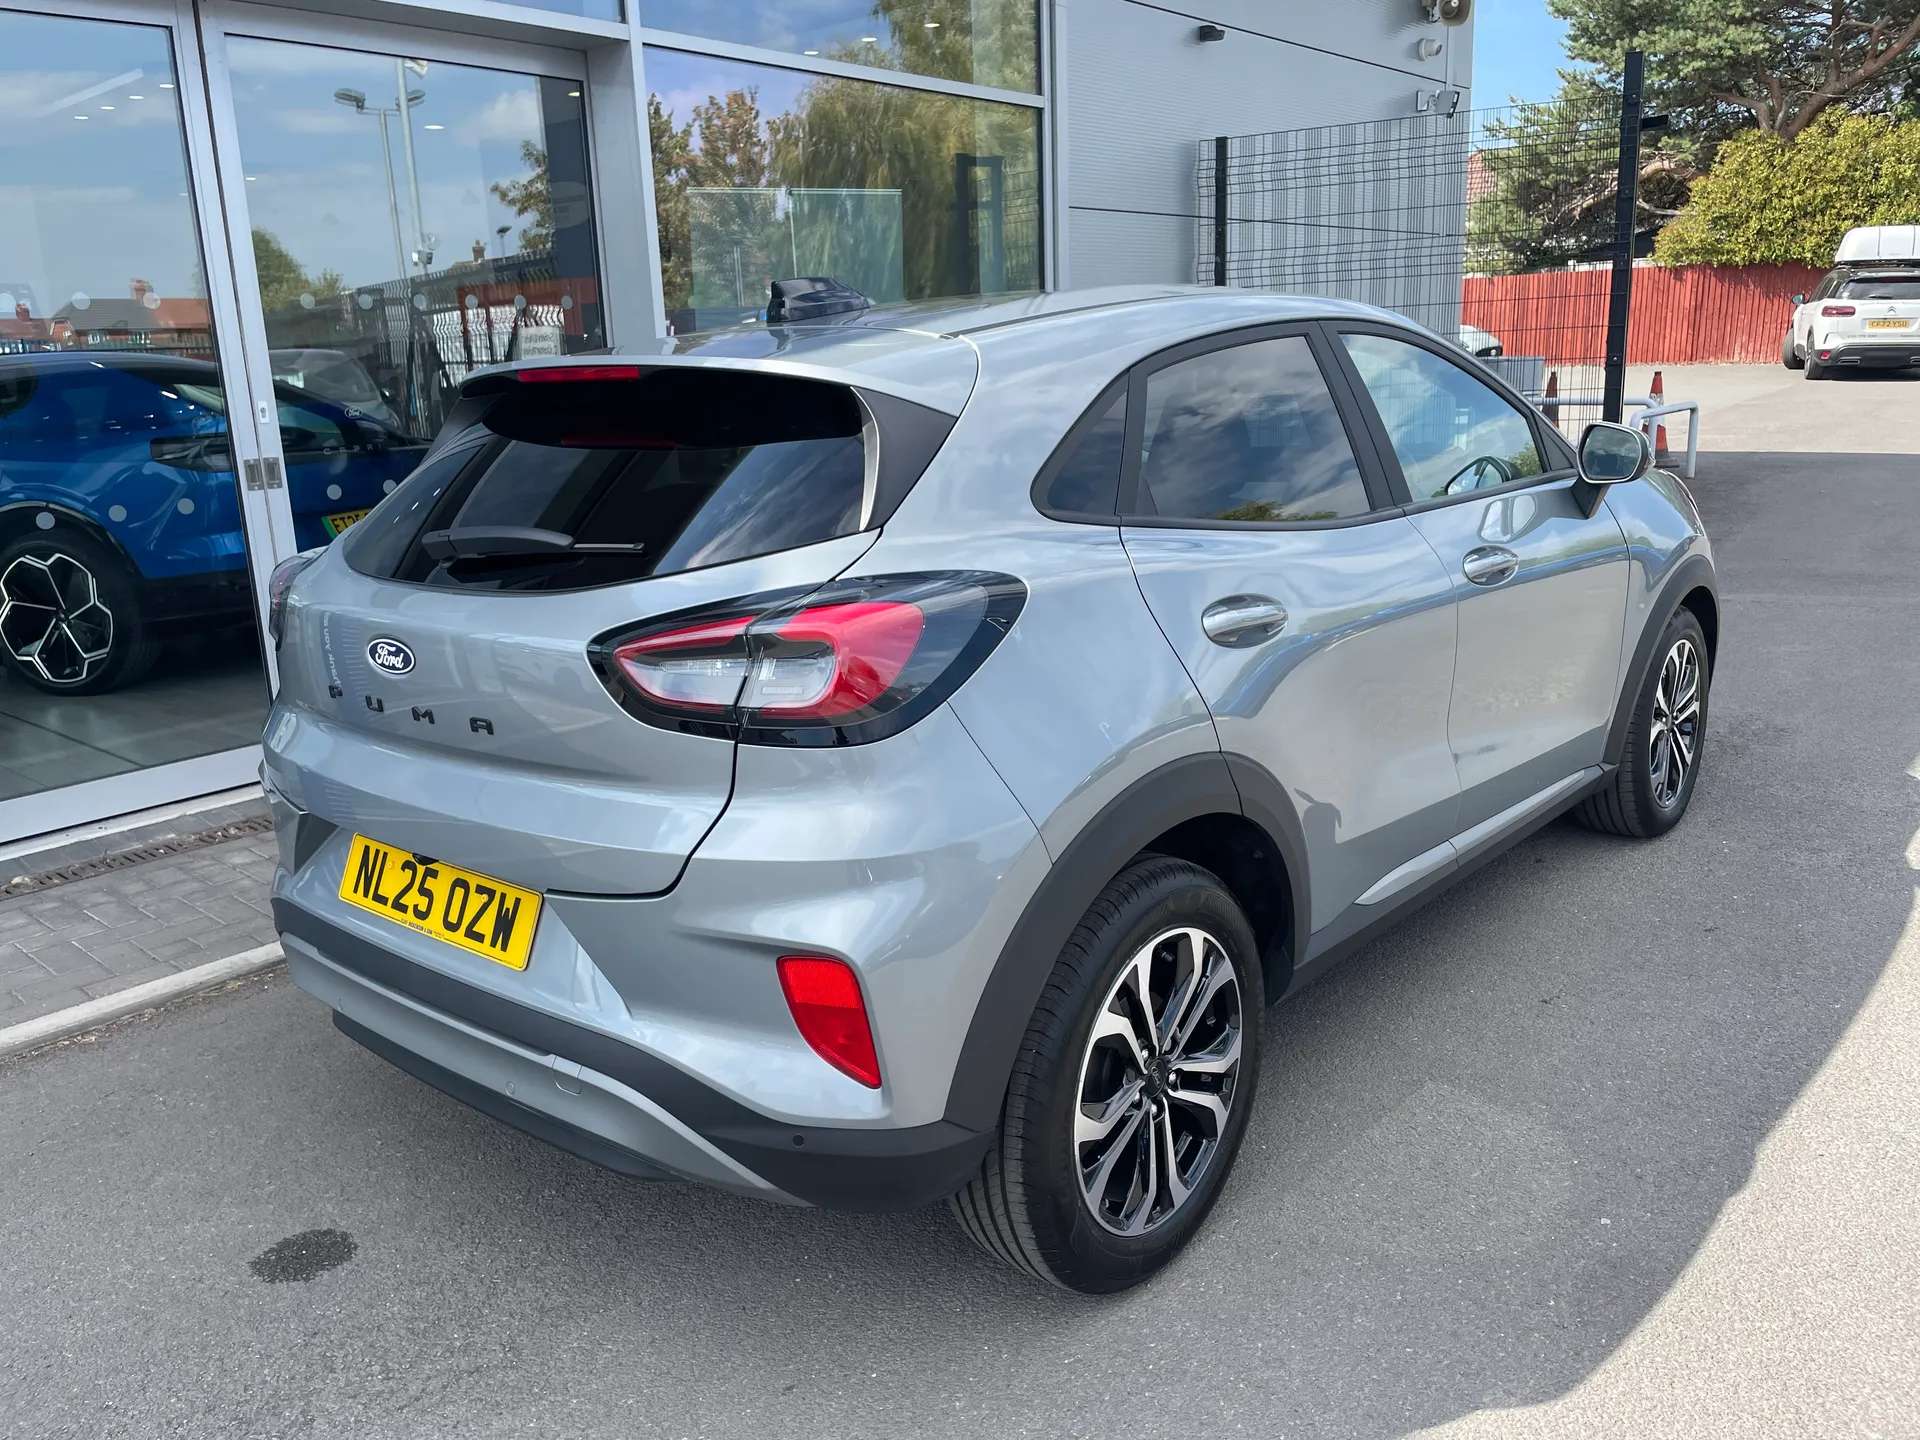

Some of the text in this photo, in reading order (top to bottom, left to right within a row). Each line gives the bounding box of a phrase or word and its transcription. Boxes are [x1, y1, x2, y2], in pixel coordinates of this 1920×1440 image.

[328, 684, 495, 735] PUMA
[353, 845, 521, 953] NL25 OZW
